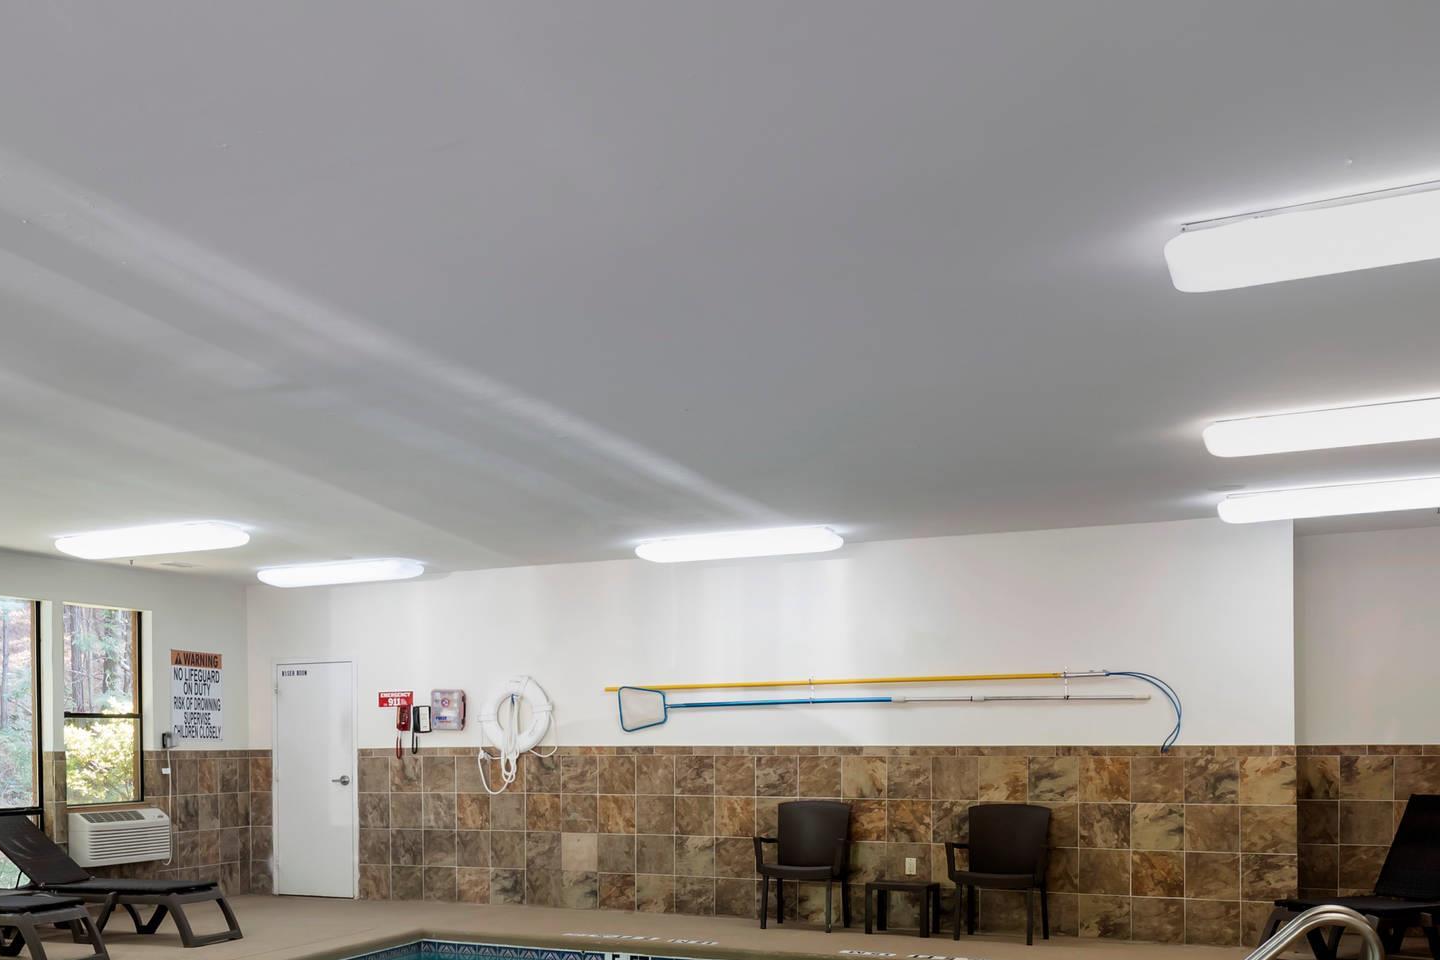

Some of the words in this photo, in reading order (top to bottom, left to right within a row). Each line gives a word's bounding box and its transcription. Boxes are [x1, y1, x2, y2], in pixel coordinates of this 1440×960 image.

[183, 652, 219, 668] WARNING
[174, 667, 184, 680] NO
[184, 668, 220, 683] LIFEGUARD
[183, 682, 193, 695] ON
[194, 683, 211, 696] DUTY
[174, 696, 185, 710] RISK
[186, 697, 193, 710] OF
[194, 698, 221, 711] DROWNING
[388, 698, 401, 706] 911
[184, 712, 211, 725] SUPERVISE
[174, 724, 199, 738] CHILDREN
[200, 726, 221, 739] CLOSELY
